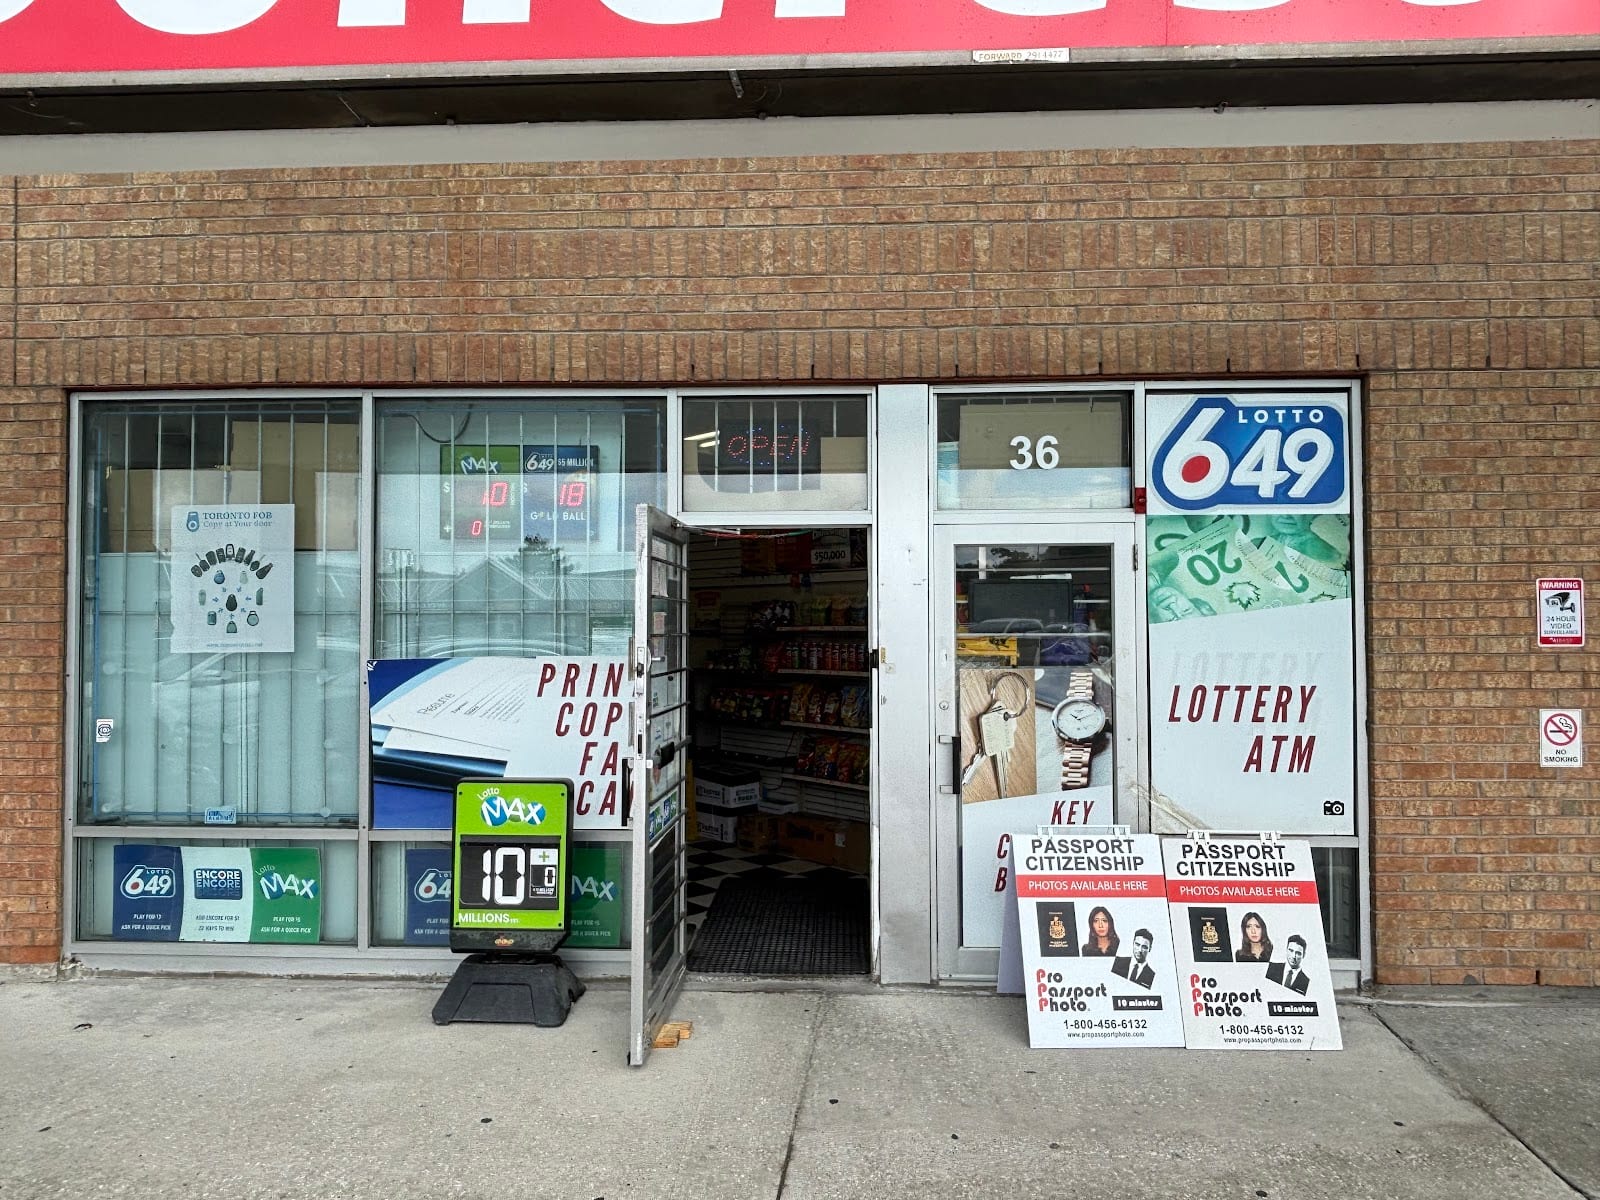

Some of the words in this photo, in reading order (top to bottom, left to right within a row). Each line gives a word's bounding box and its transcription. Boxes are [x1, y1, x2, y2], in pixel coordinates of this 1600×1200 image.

[1238, 409, 1324, 423] LOTTO
[728, 435, 811, 456] OPEN
[1009, 435, 1060, 470] 36
[1161, 407, 1335, 499] 649
[461, 456, 498, 475] MAX
[526, 454, 554, 471] 649
[560, 482, 585, 507] 18
[203, 511, 251, 520] TORONTO
[253, 511, 273, 520] FOB
[562, 511, 586, 521] BALL
[203, 521, 223, 529] Copy
[814, 550, 846, 561] $50,000
[1541, 581, 1579, 589] WARNING
[536, 663, 634, 698] PRIN
[1168, 685, 1317, 722] LOTTERY
[555, 702, 623, 737] COP
[578, 741, 620, 776] FA
[1243, 735, 1316, 773] ATM
[477, 787, 500, 801] Lotto
[481, 796, 543, 827] MAX
[1051, 800, 1095, 825] KEY
[1031, 838, 1135, 854] PASSPORT
[1181, 844, 1286, 860] PASSPORT
[255, 864, 276, 876] Lotto
[1025, 856, 1145, 871] CITIZENSHIP
[1176, 861, 1296, 877] CITIZENSHIP
[125, 868, 172, 896] 649
[195, 870, 241, 880] ENCORE
[481, 847, 526, 905] 10
[544, 866, 556, 887] 0
[196, 880, 241, 888] ENCORE
[260, 872, 315, 900] MAX
[418, 872, 452, 899] 64
[1028, 880, 1068, 890] PHOTOS
[1070, 881, 1121, 890] AVAILABLE
[1123, 881, 1148, 890] HERE
[1180, 885, 1219, 896] PHOTOS
[1222, 886, 1272, 897] AVAILABLE
[1275, 887, 1300, 897] HERE
[458, 912, 510, 923] MILLIONS
[1036, 969, 1063, 983] Pro
[1190, 973, 1218, 988] Pro
[1037, 983, 1107, 1001] Passport
[1191, 988, 1262, 1006] Passport
[1117, 999, 1127, 1007] 10
[1128, 999, 1158, 1007] minutes
[1273, 1005, 1283, 1013] 10
[1285, 1005, 1314, 1013] minutes
[1063, 1019, 1148, 1029] 1-800-456-6132
[1219, 1024, 1305, 1035] 1-800-456-6132
[1067, 1031, 1145, 1039] www.propassportphoto.com
[1224, 1036, 1302, 1044] www.propassportphoto.com
